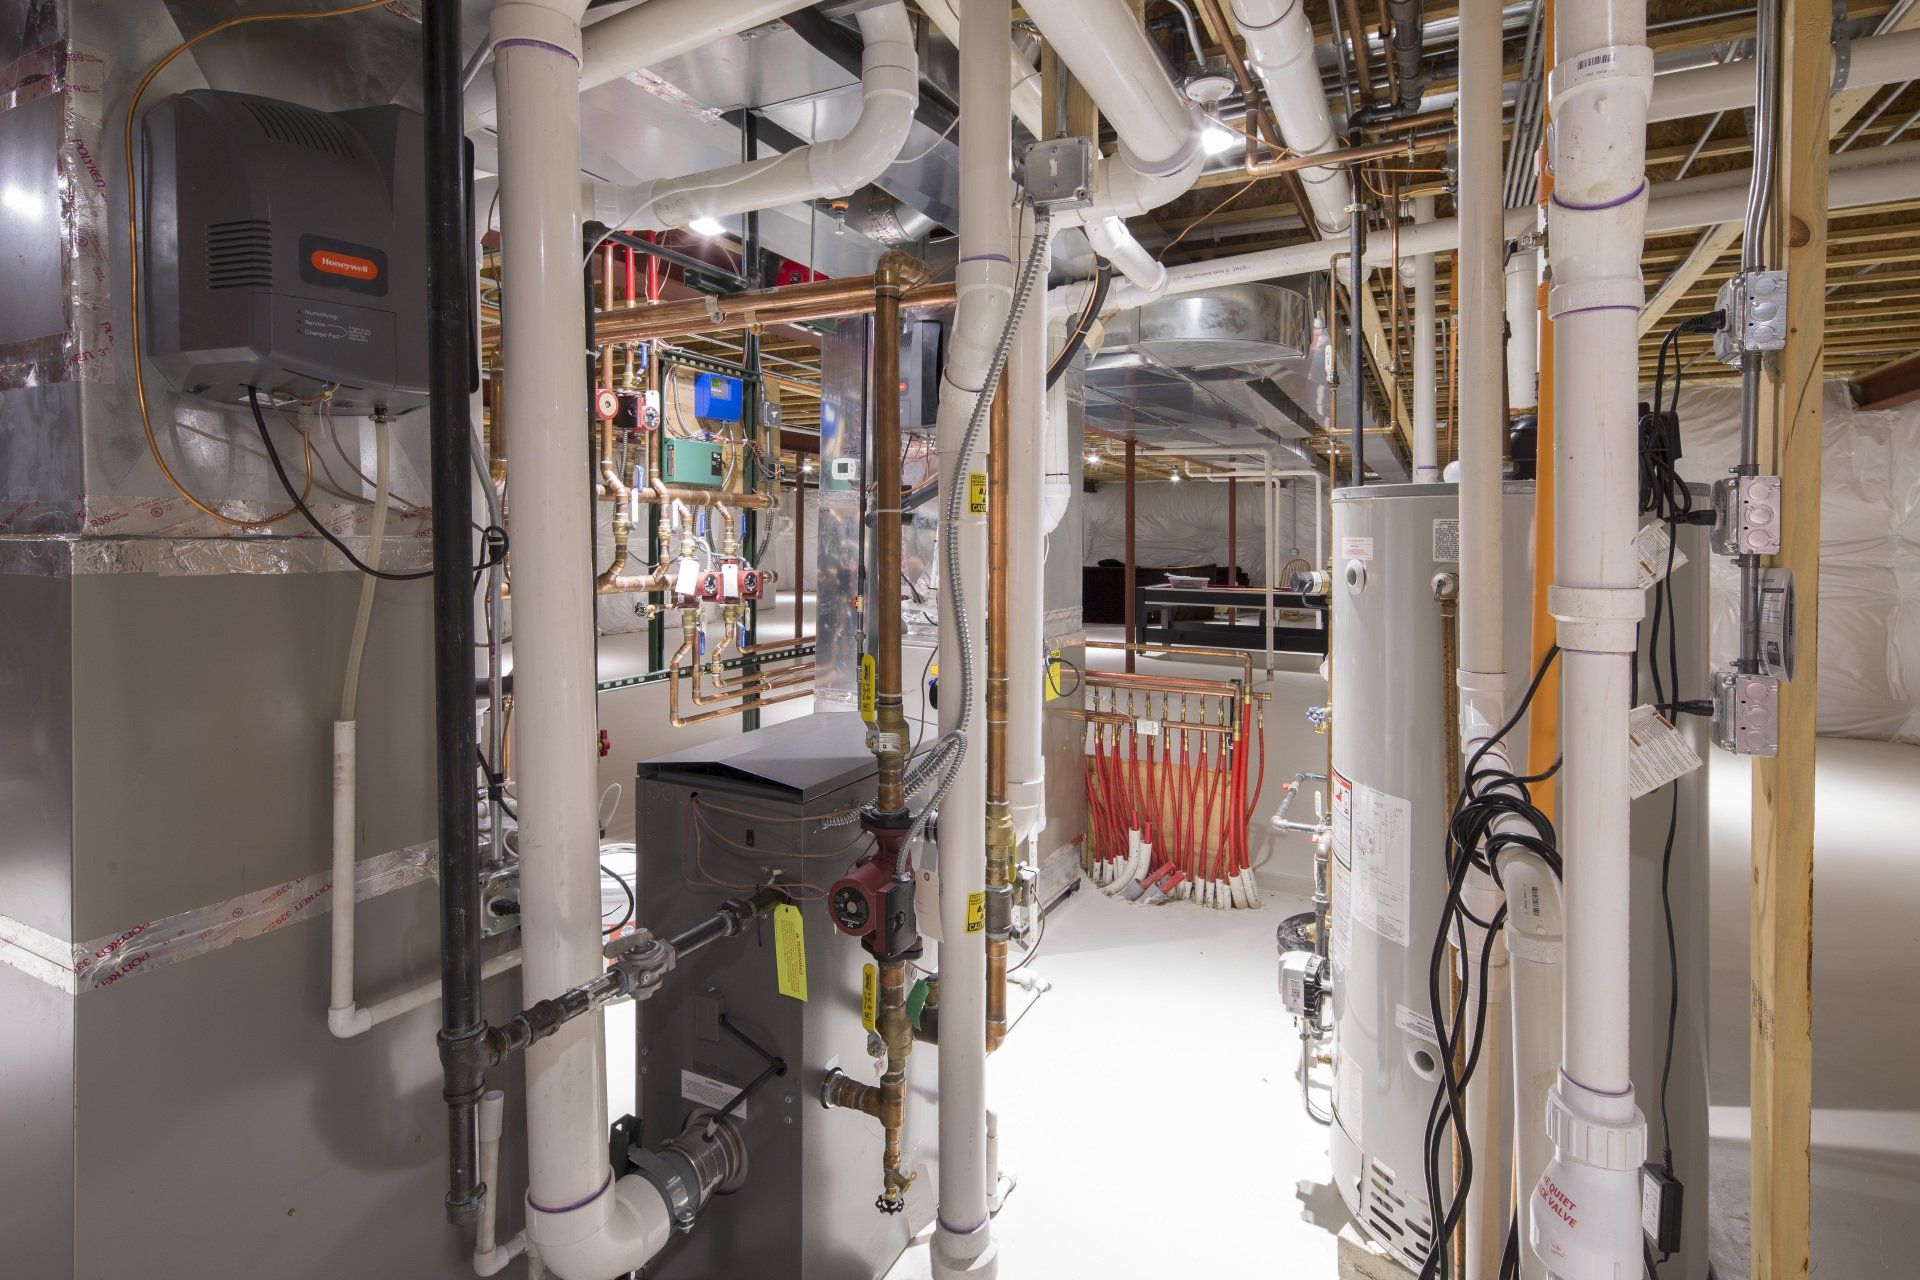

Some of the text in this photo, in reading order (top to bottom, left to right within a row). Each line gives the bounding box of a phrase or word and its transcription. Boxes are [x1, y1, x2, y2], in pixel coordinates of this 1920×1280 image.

[321, 257, 369, 273] Honeywell
[304, 309, 338, 320] Humidifying
[304, 320, 326, 328] Service
[1549, 1182, 1577, 1212] QUIET
[1548, 1196, 1578, 1229] VALVE
